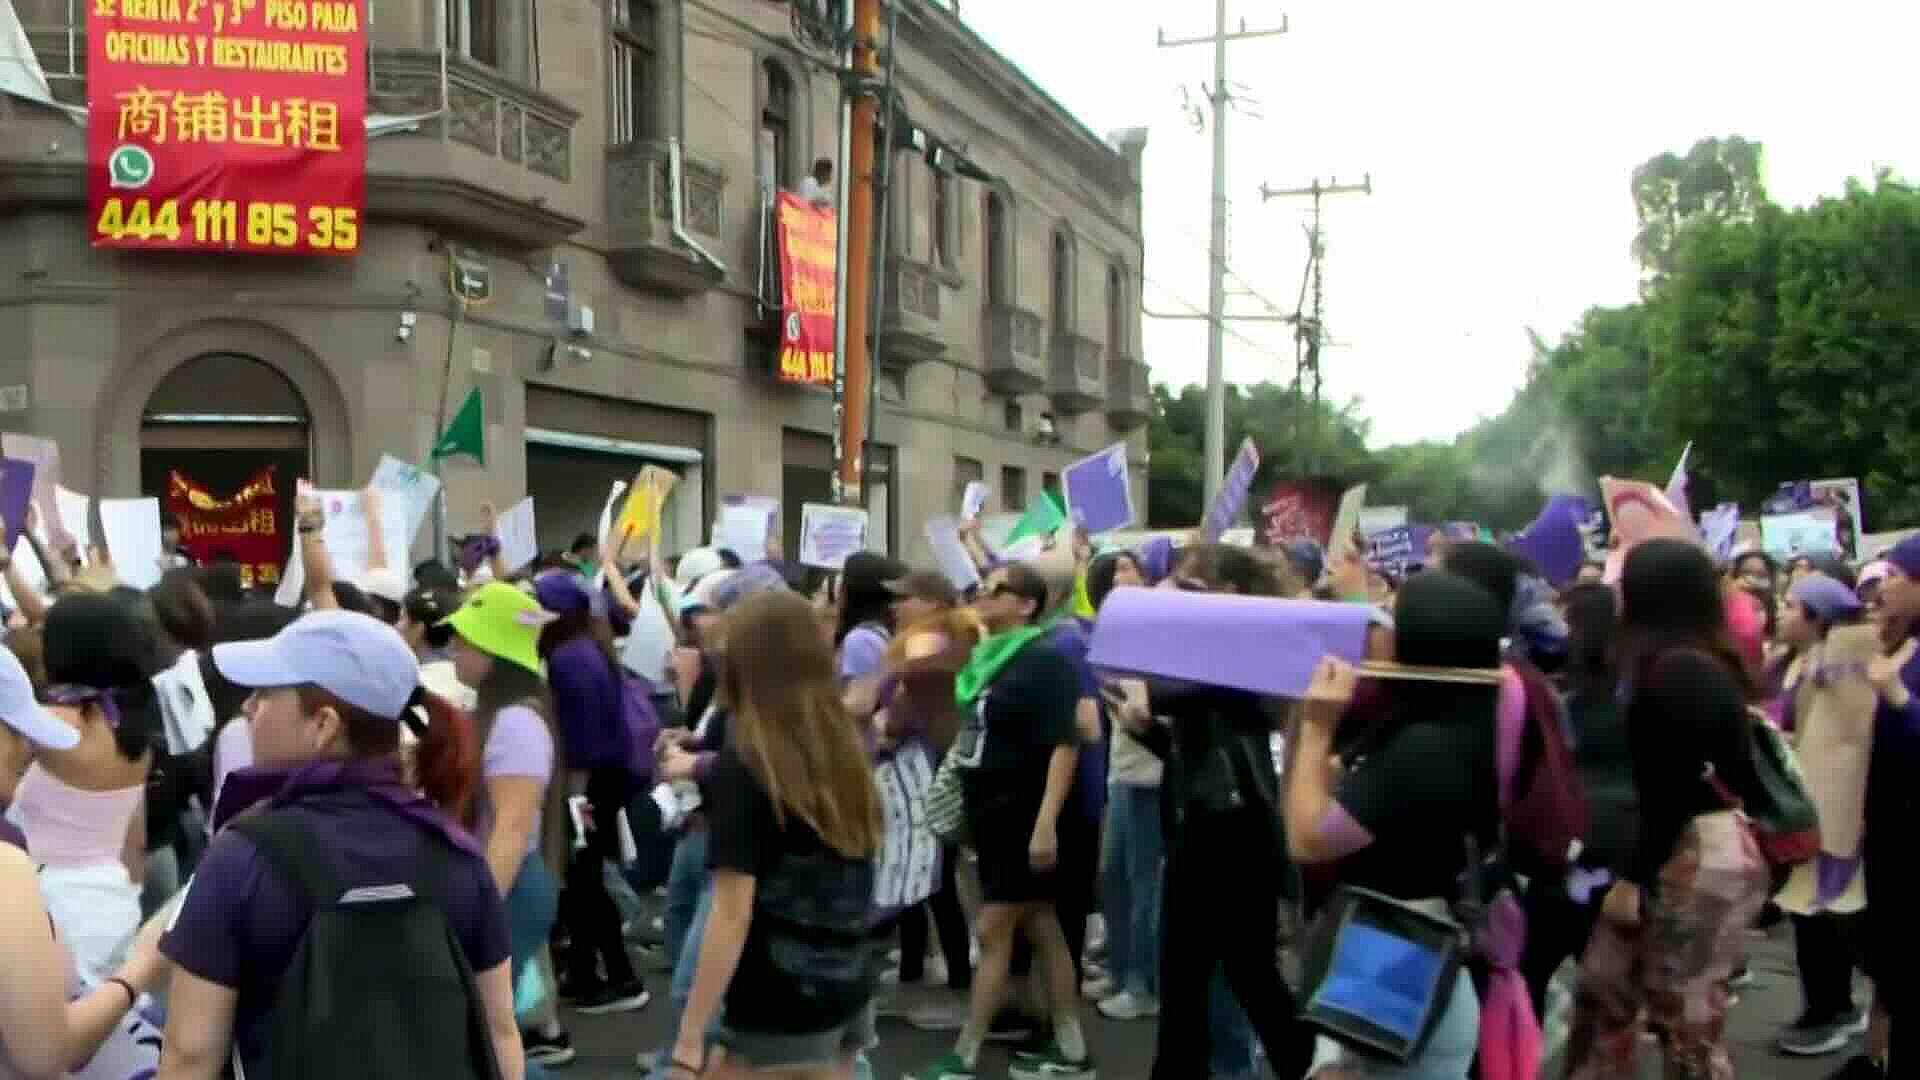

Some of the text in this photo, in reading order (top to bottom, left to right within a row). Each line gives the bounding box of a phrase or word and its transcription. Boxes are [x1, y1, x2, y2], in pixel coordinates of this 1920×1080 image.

[122, 0, 180, 22] RENTA
[213, 3, 224, 33] y
[265, 1, 307, 31] PISO
[312, 3, 358, 33] PARA
[105, 31, 348, 76] OFICINAS Y RESTAURANTES
[114, 86, 342, 151] 商铺出租
[97, 198, 358, 250] 444 111 85 35
